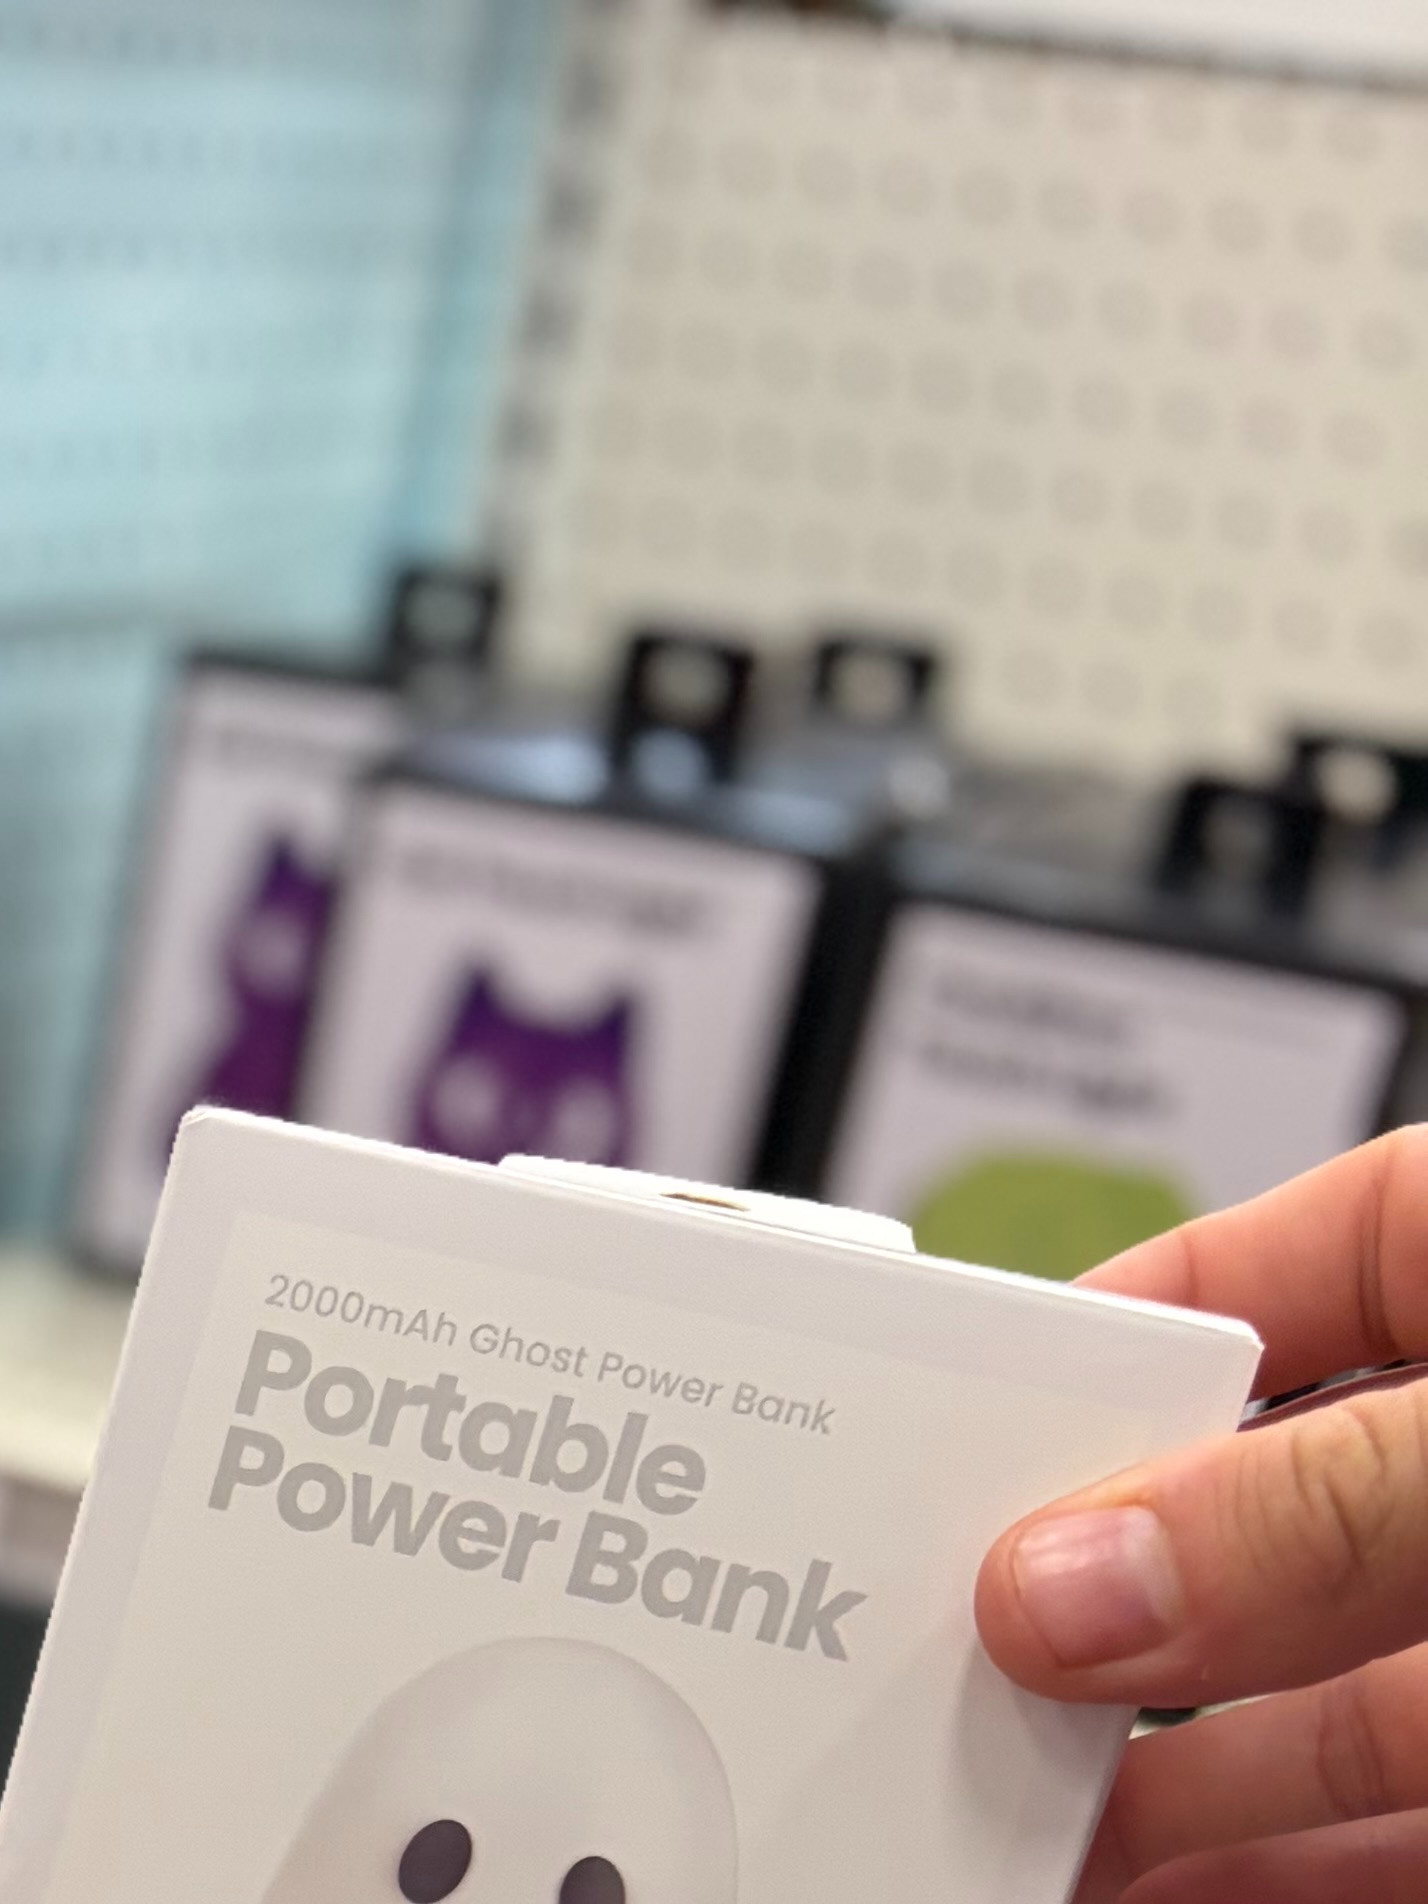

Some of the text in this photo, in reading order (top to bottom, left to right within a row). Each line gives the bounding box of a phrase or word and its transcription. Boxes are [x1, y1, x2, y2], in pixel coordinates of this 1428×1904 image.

[235, 1329, 707, 1517] Portable
[264, 1273, 836, 1436] 2000mAh Ghost Power Bank
[208, 1424, 868, 1664] Power Bank
